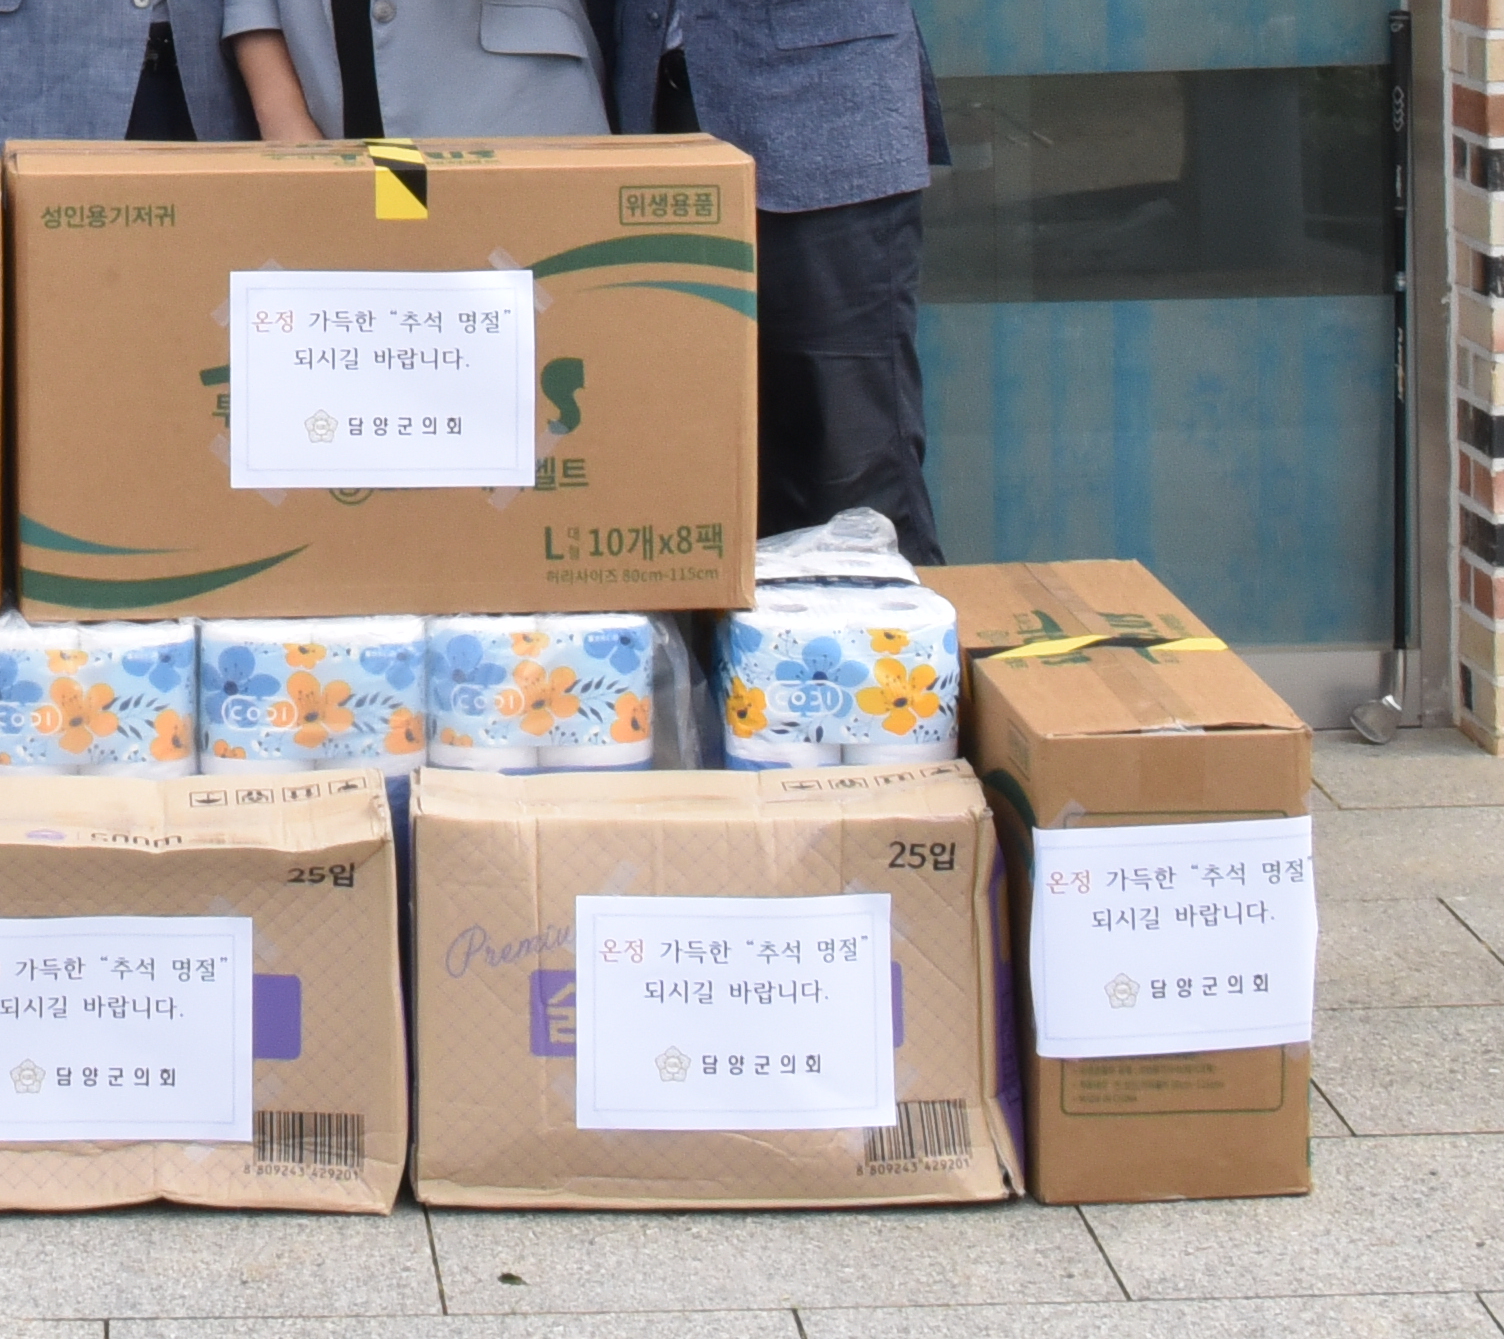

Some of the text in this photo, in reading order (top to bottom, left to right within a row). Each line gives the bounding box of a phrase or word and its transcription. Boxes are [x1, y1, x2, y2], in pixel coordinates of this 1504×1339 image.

[41, 203, 175, 229] 성인용기저귀
[624, 192, 714, 220] 위생용품
[252, 310, 293, 333] 온정
[310, 310, 376, 332] 가득한
[295, 348, 469, 370] 되시길 바랍니다.
[349, 417, 461, 436] 담양군의회
[545, 526, 564, 560] L
[889, 841, 956, 871] 25입
[287, 862, 356, 888] 25입
[1046, 870, 1090, 894] 온정
[1107, 866, 1176, 892] 가득한
[1093, 900, 1274, 932] 되시길 바랍니다.
[599, 939, 643, 963] 온정
[661, 940, 731, 964] 가득한
[16, 957, 85, 981] 가득한
[645, 980, 828, 1004] 되시길 바랍니다.
[1151, 974, 1268, 999] 담양군의회
[0, 996, 183, 1020] 되시길 바랍니다.
[57, 1067, 175, 1087] 담양군의회
[702, 1055, 821, 1075] 담양군의회
